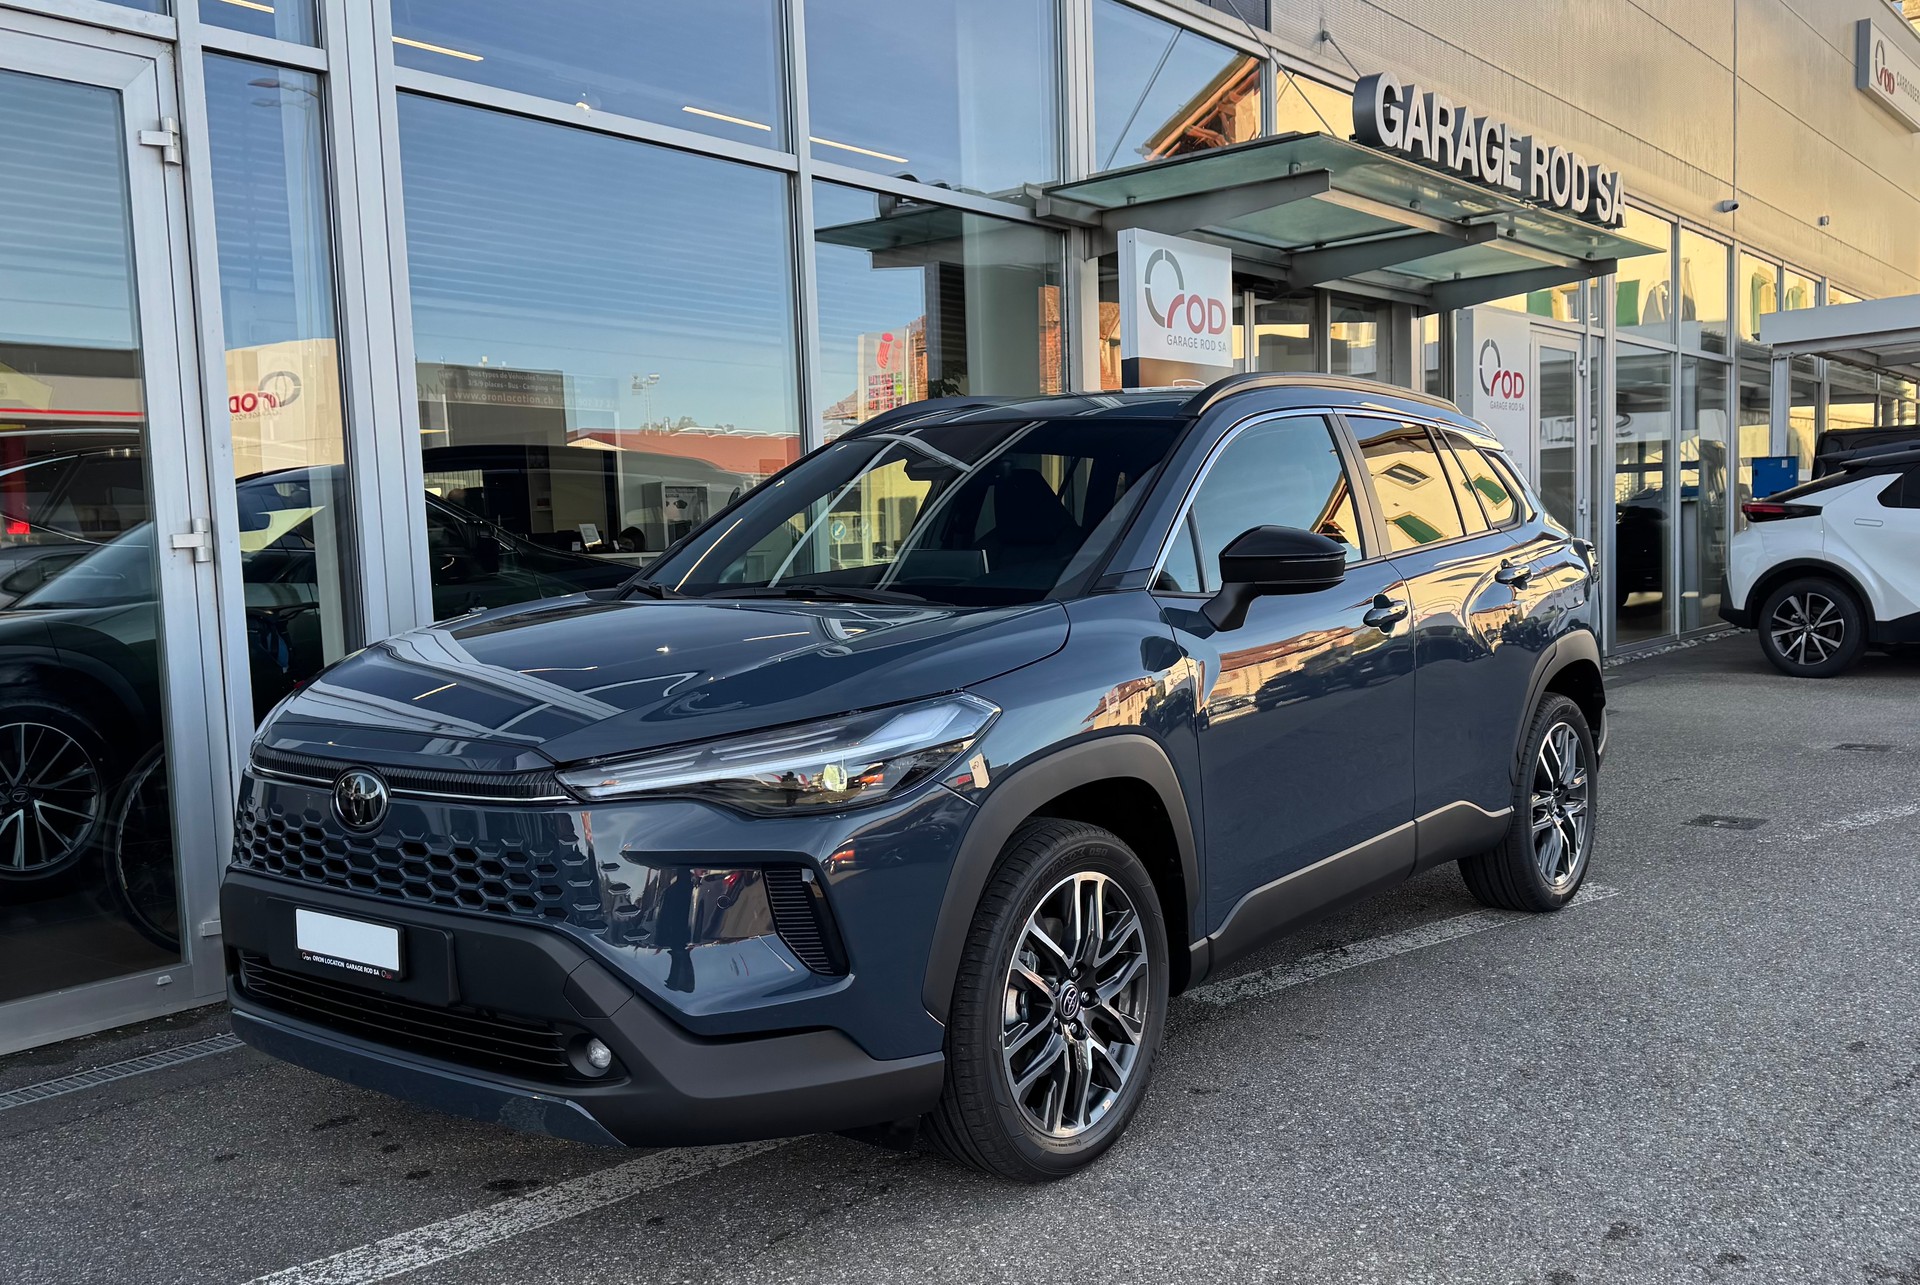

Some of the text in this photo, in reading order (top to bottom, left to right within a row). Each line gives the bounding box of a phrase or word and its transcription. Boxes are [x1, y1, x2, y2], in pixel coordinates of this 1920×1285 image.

[1367, 71, 1627, 228] GARAGE ROD SA
[1166, 334, 1227, 352] GARAGE ROD SA
[1489, 400, 1525, 412] GARAGE ROD SA
[325, 958, 345, 968] LOCATION
[346, 963, 363, 972] GARAGE
[364, 966, 373, 974] ROD
